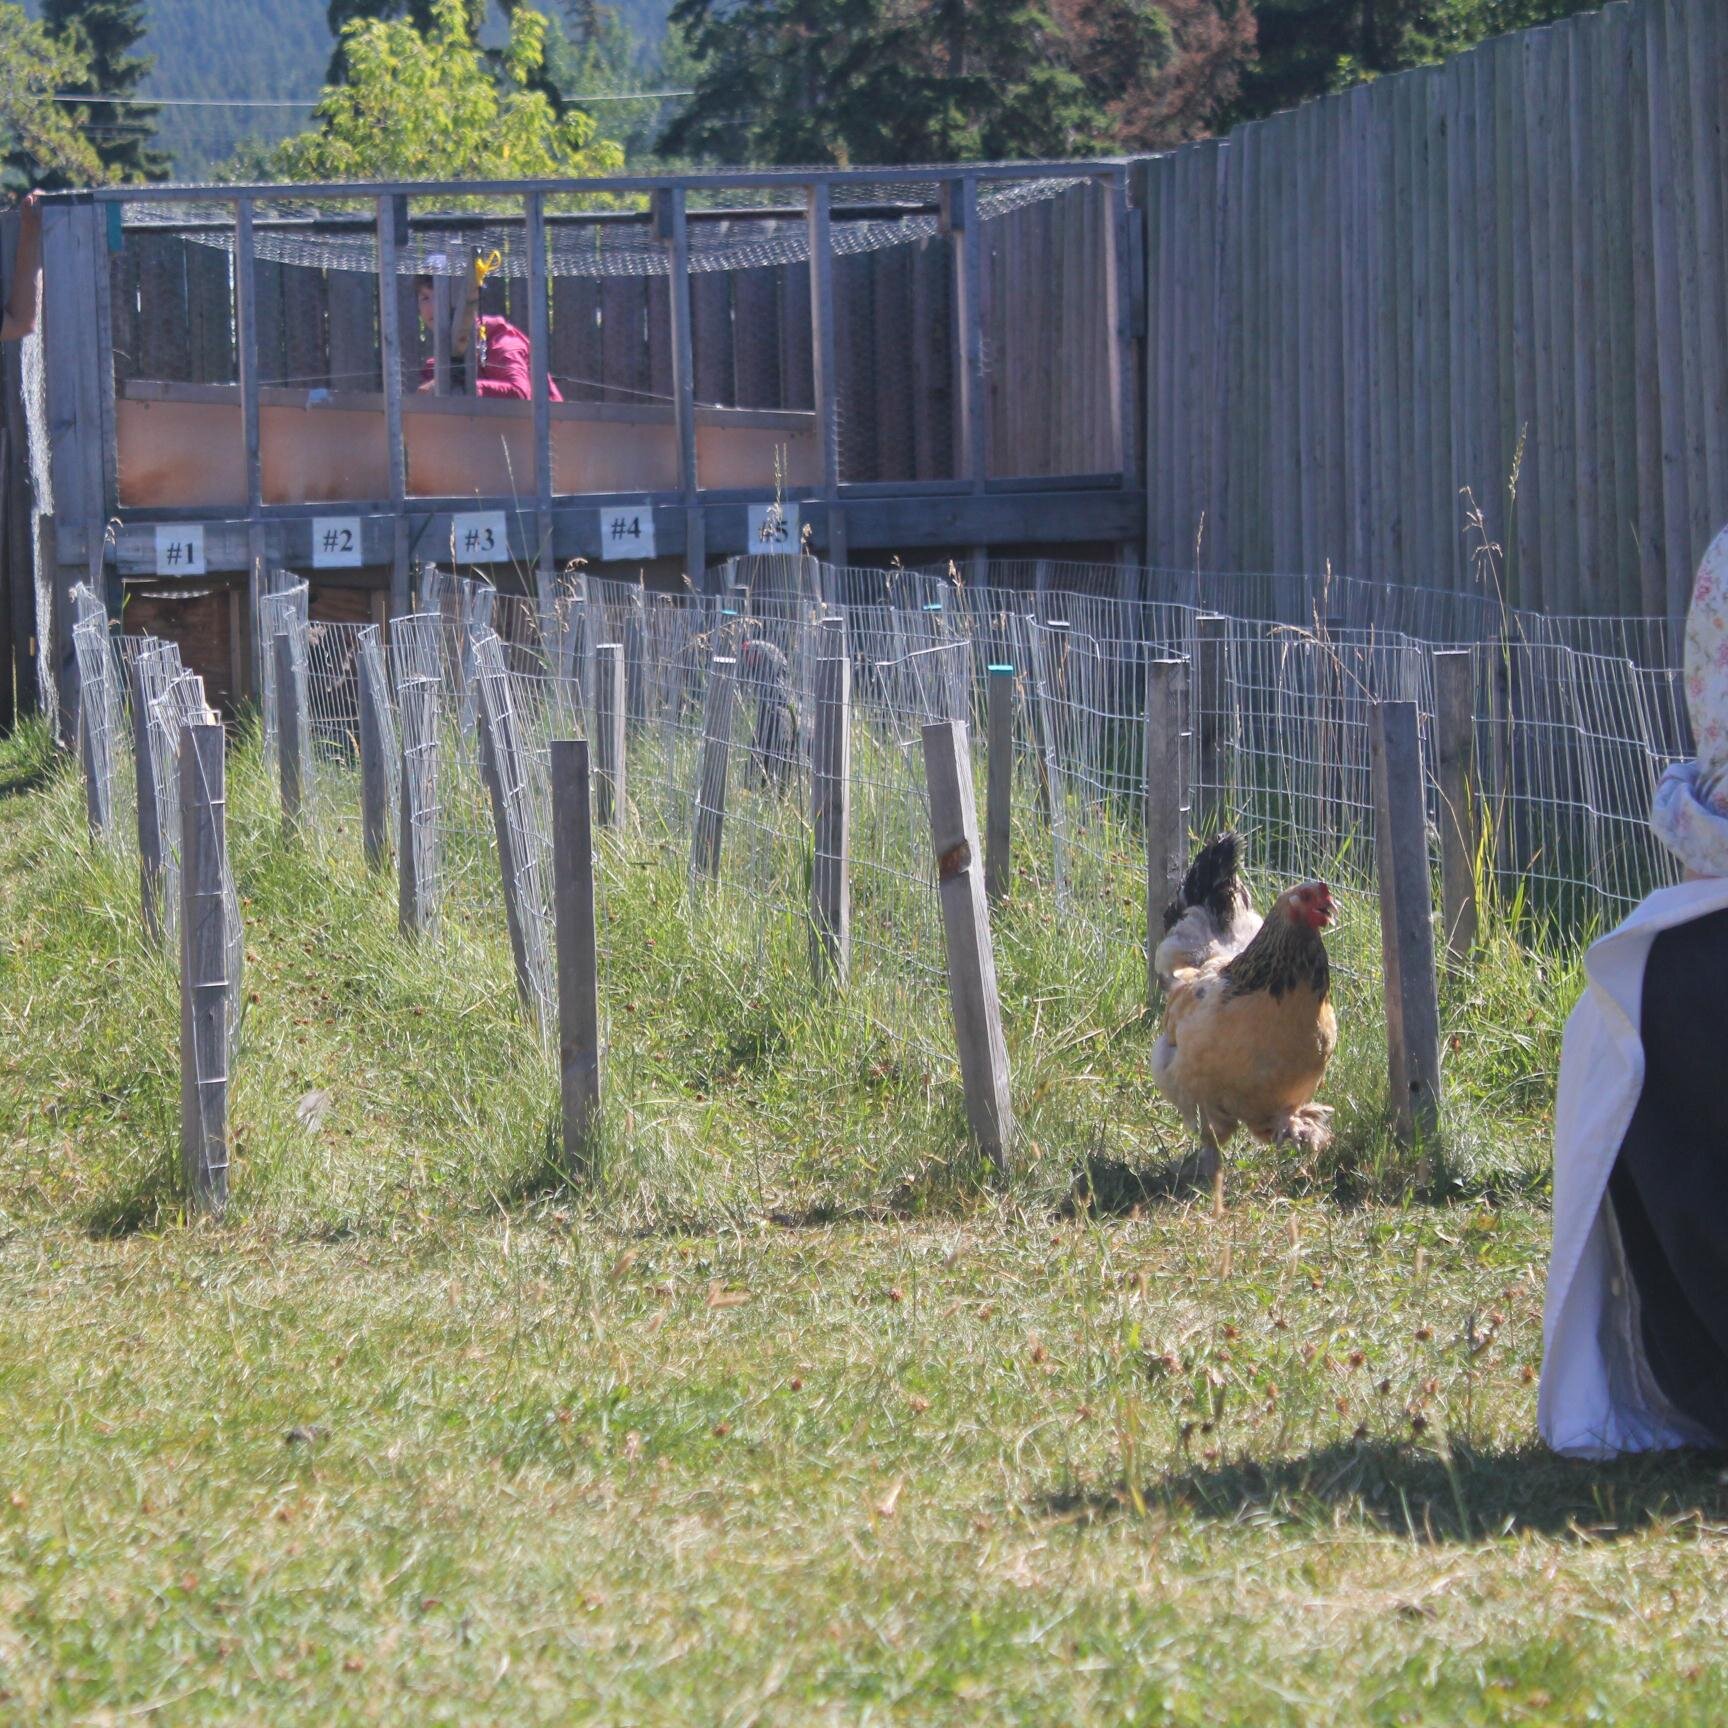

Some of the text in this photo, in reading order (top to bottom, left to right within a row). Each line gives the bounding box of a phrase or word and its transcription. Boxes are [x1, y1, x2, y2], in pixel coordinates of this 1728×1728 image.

[464, 528, 496, 551] #3
[610, 517, 642, 540] #4
[323, 529, 354, 553] #2
[166, 542, 195, 565] #1
